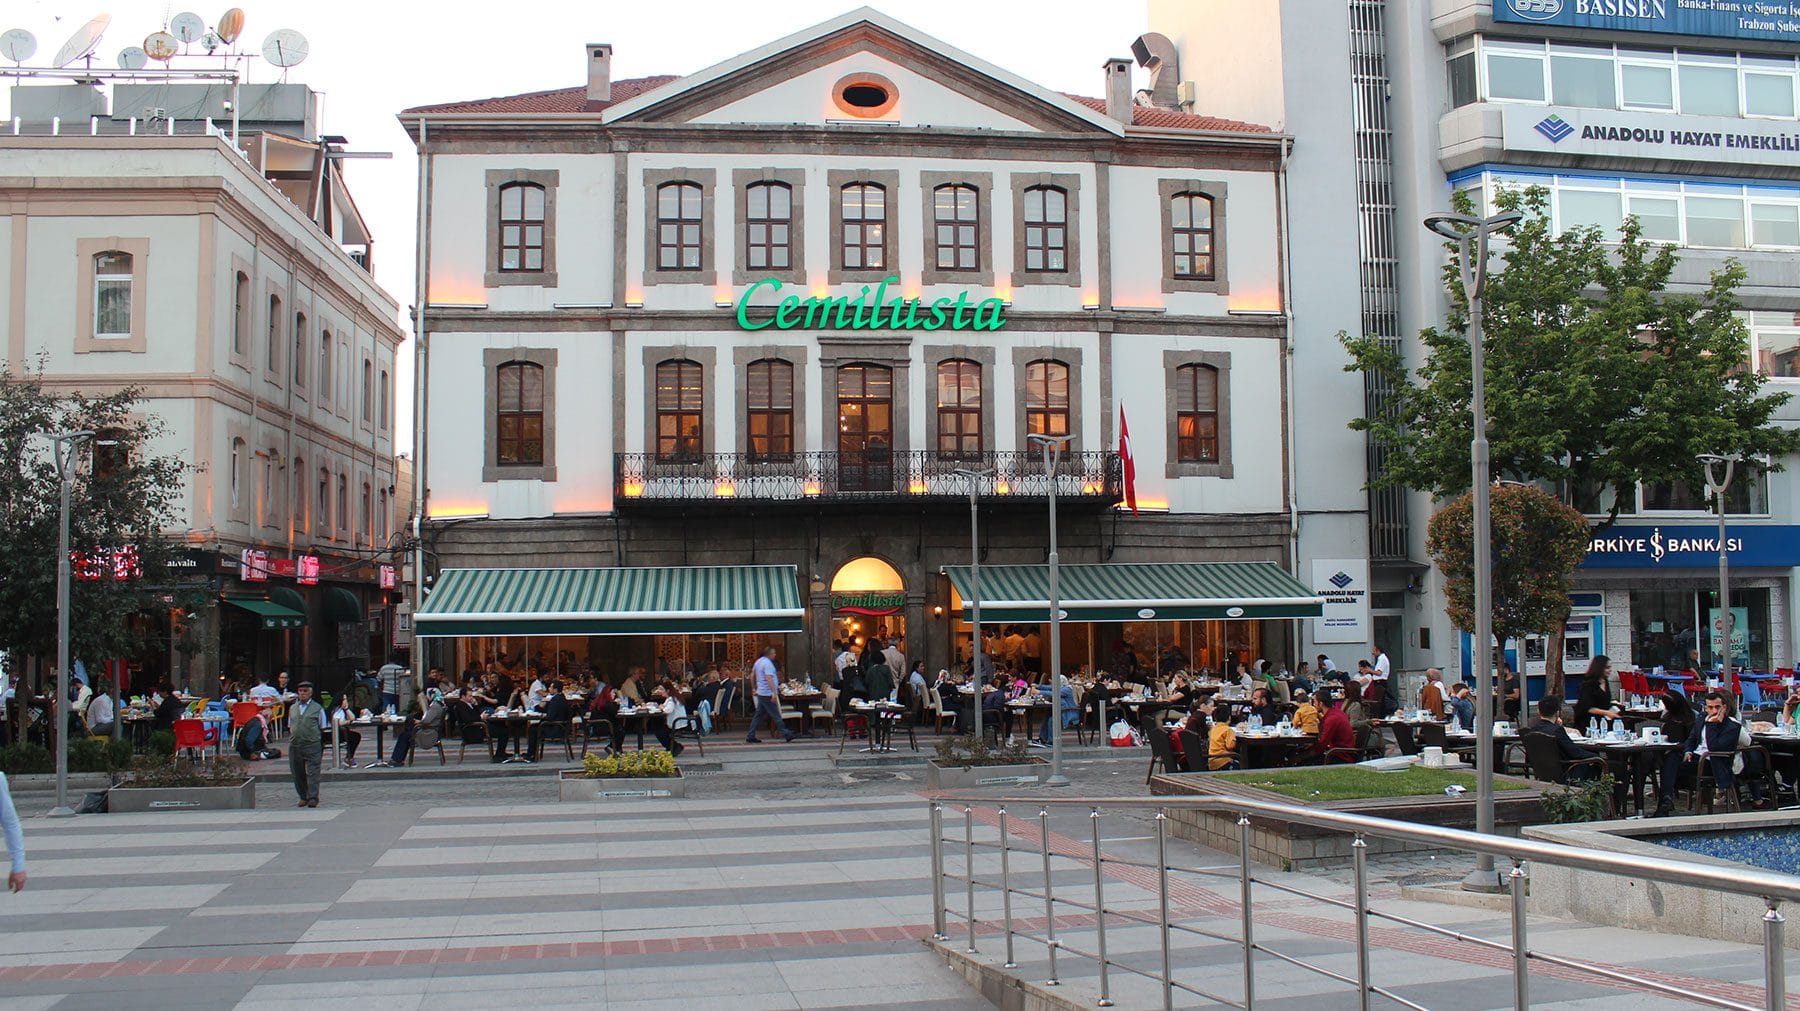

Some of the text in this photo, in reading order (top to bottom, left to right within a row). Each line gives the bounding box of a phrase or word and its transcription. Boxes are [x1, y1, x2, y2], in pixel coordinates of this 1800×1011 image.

[1677, 0, 1740, 12] Banka-Finans
[1743, 3, 1753, 12] ve
[1755, 1, 1787, 16] Sigorta
[1737, 17, 1800, 33] Trabzon Şube
[1581, 125, 1664, 144] ANADOLU
[1670, 130, 1721, 147] HAYAT
[737, 276, 1006, 331] Cemilusta
[1585, 535, 1646, 552] RKİYE
[832, 592, 905, 609] Cemilusta
